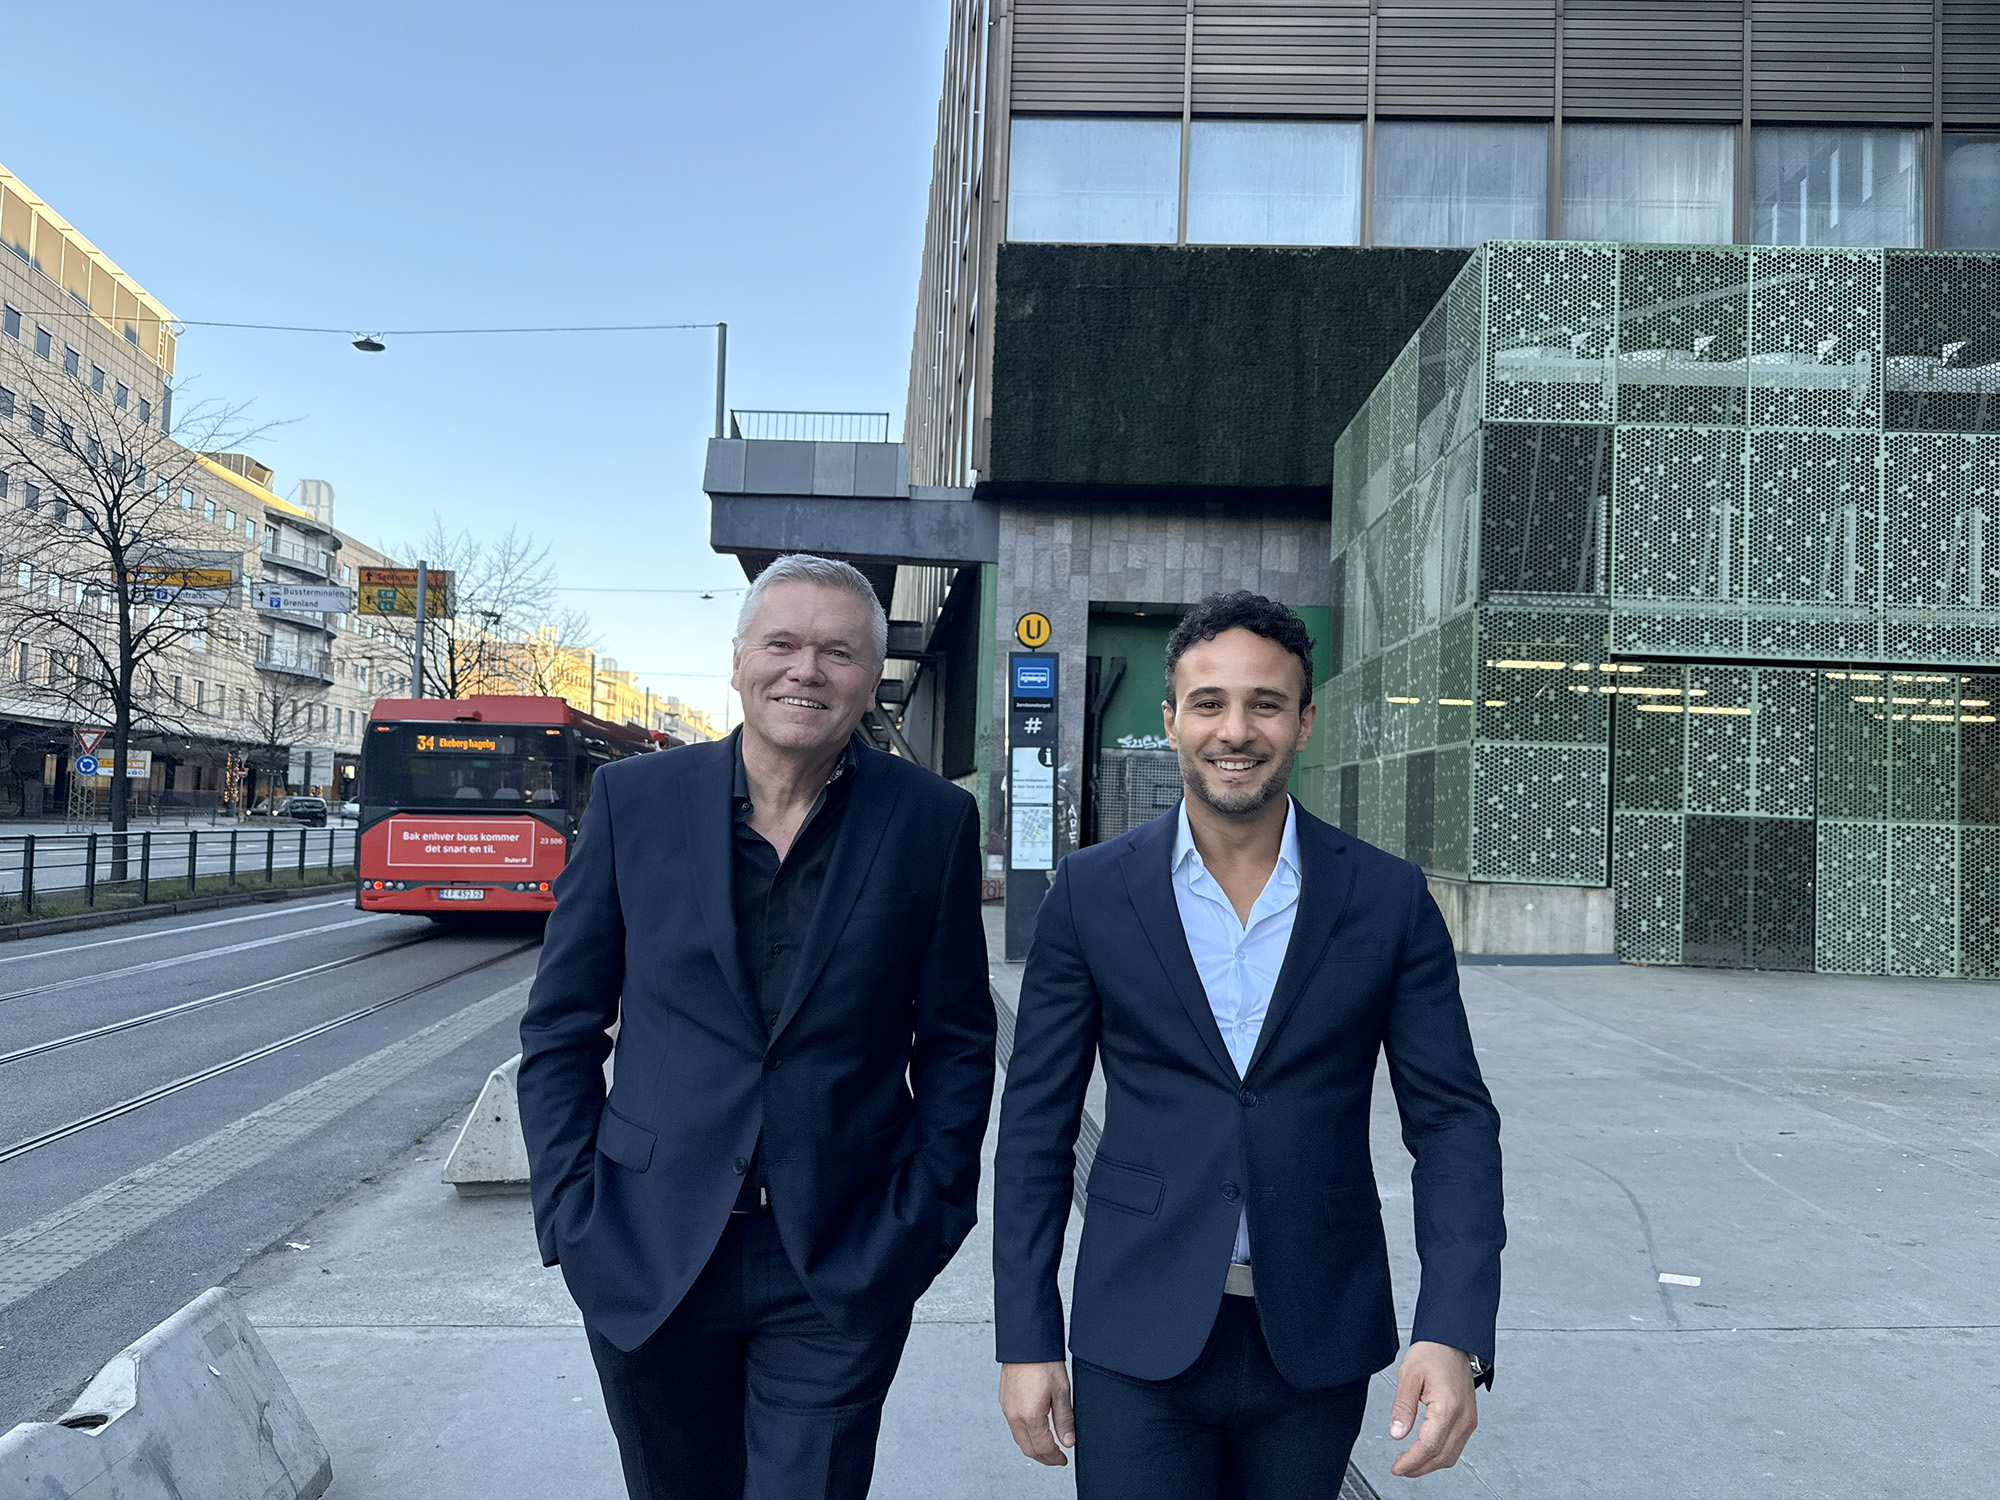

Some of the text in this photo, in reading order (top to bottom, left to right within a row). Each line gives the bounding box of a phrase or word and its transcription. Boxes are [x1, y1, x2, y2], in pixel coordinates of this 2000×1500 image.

[283, 587, 345, 597] Bussterminalen
[283, 599, 319, 608] Grønland
[1026, 619, 1042, 640] U
[417, 735, 496, 751] 34 Ekeberg hageby
[402, 831, 520, 843] Bak enhver buss kommer
[540, 837, 549, 845] 23
[425, 845, 496, 854] det snart en til.
